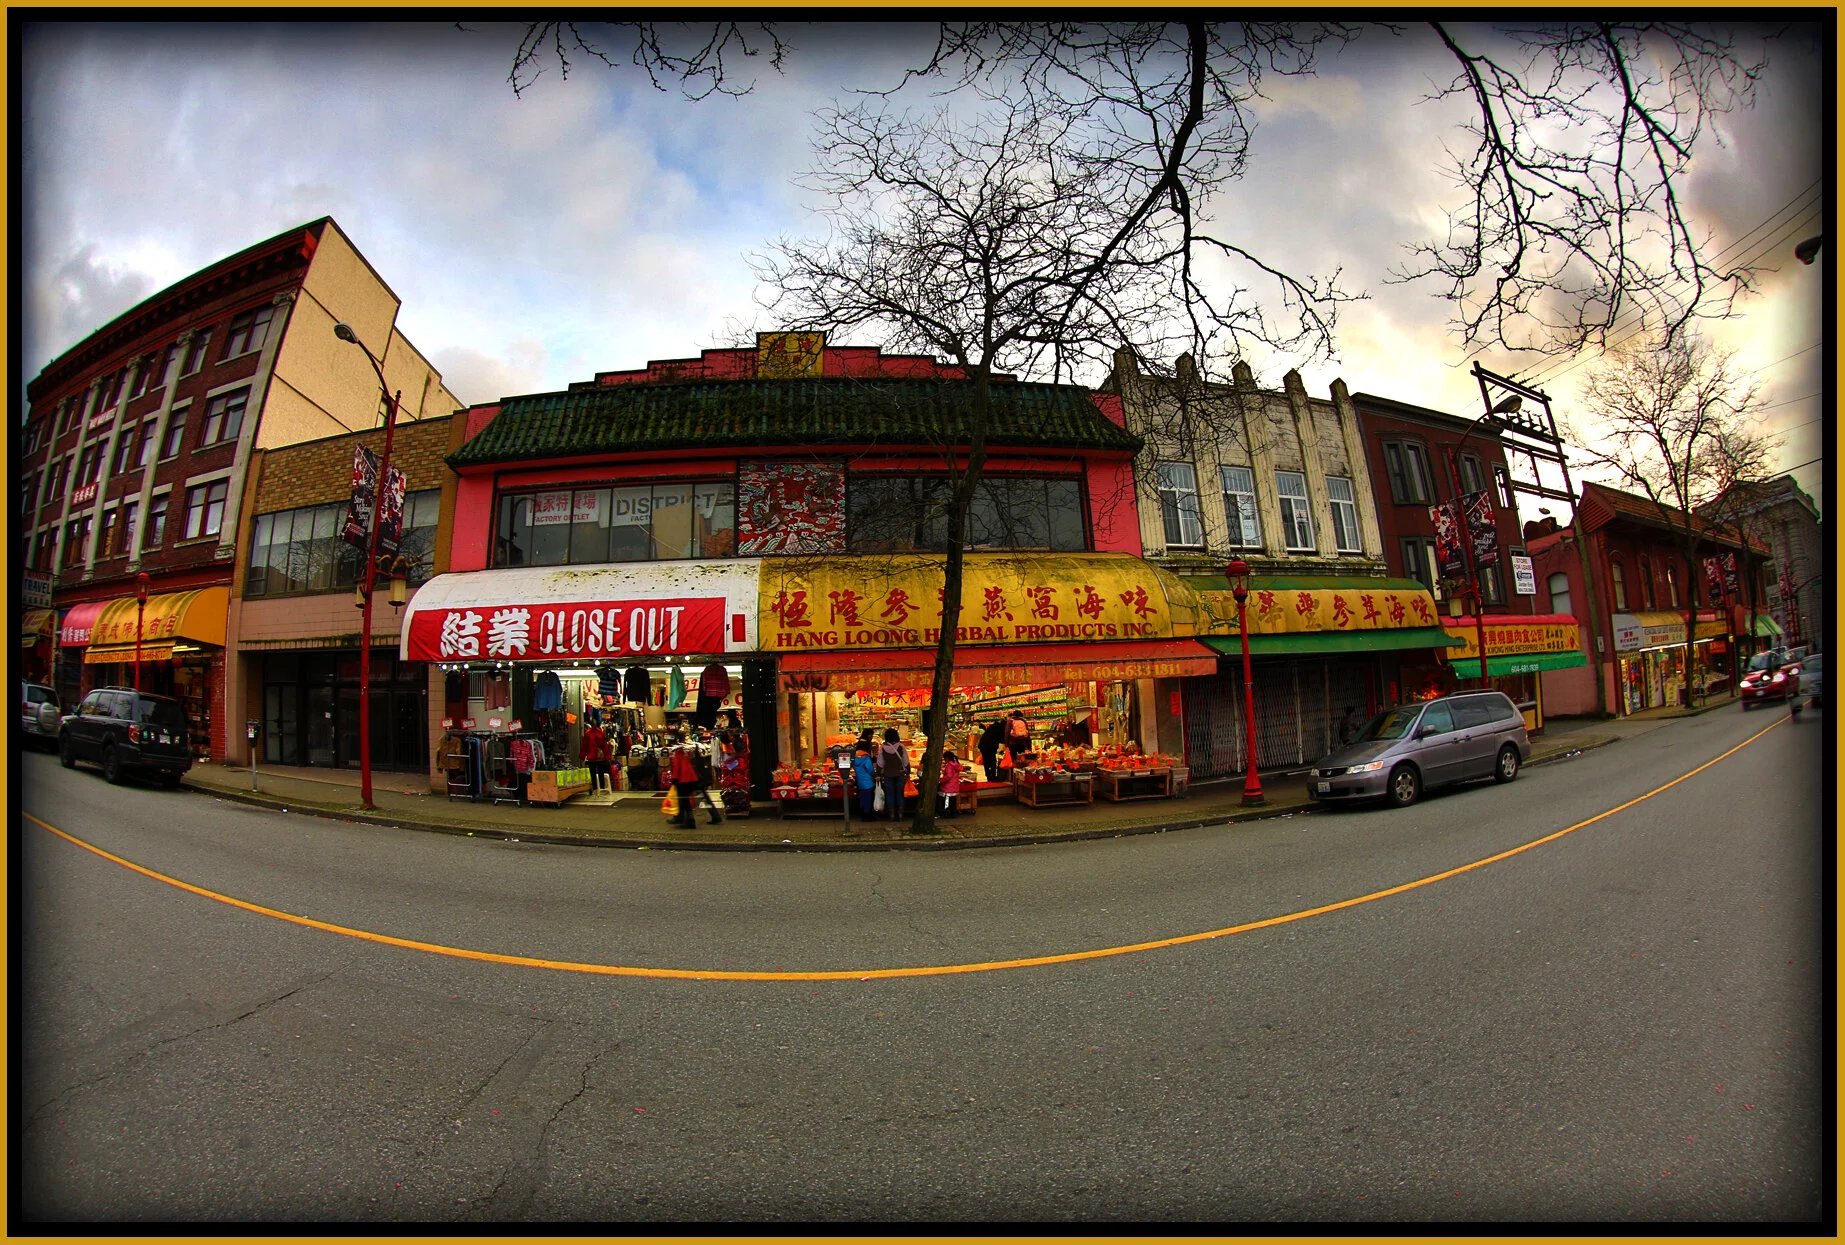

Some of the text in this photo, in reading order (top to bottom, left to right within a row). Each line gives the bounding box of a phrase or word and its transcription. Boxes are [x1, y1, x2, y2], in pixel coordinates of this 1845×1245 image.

[563, 513, 590, 521] OTLET
[23, 579, 51, 595] TRAVEL
[440, 607, 532, 658] 結業
[539, 606, 685, 654] CLOSE OUT
[777, 622, 1158, 647] HANG LOONG HRBAL PRODUCTS INC.
[1063, 665, 1088, 680] Tel:
